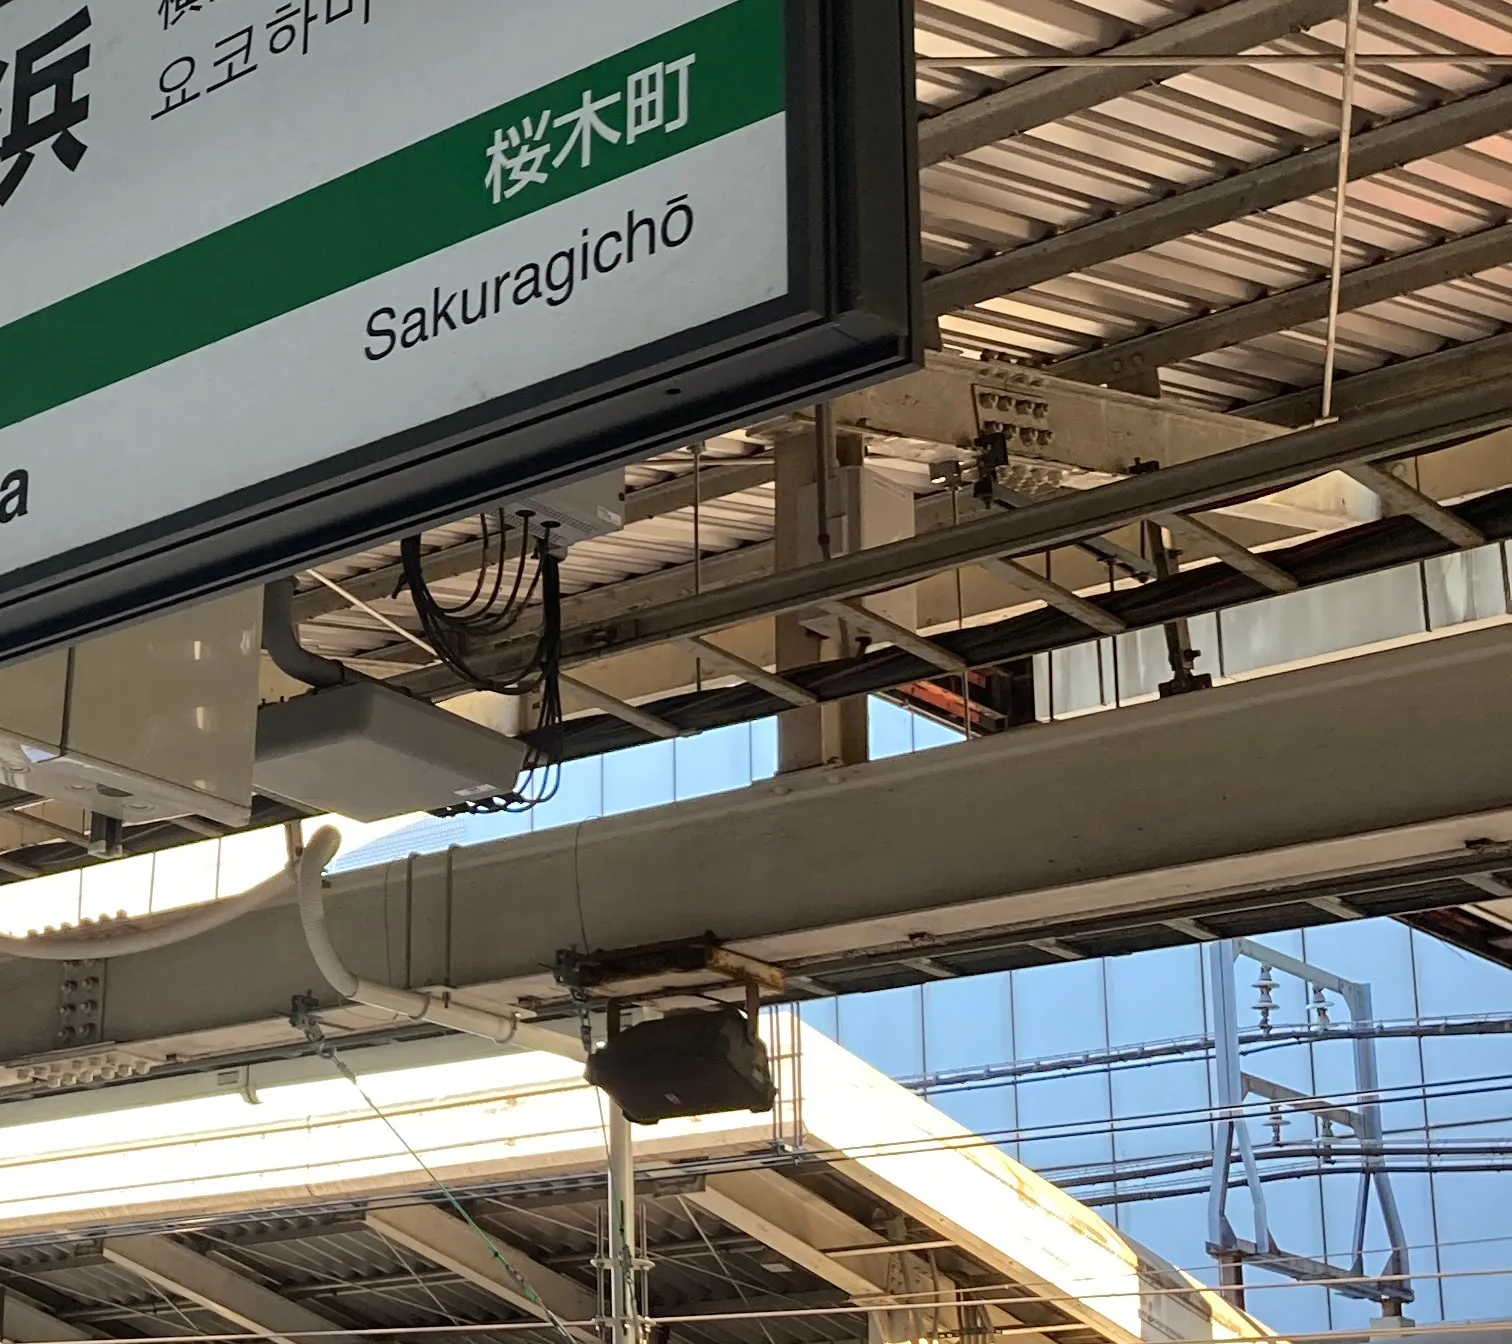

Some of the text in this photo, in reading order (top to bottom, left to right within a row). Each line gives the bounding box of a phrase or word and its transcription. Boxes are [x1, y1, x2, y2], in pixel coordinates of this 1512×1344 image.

[485, 53, 696, 205] 桜木町
[364, 194, 693, 362] Sakuragichō
